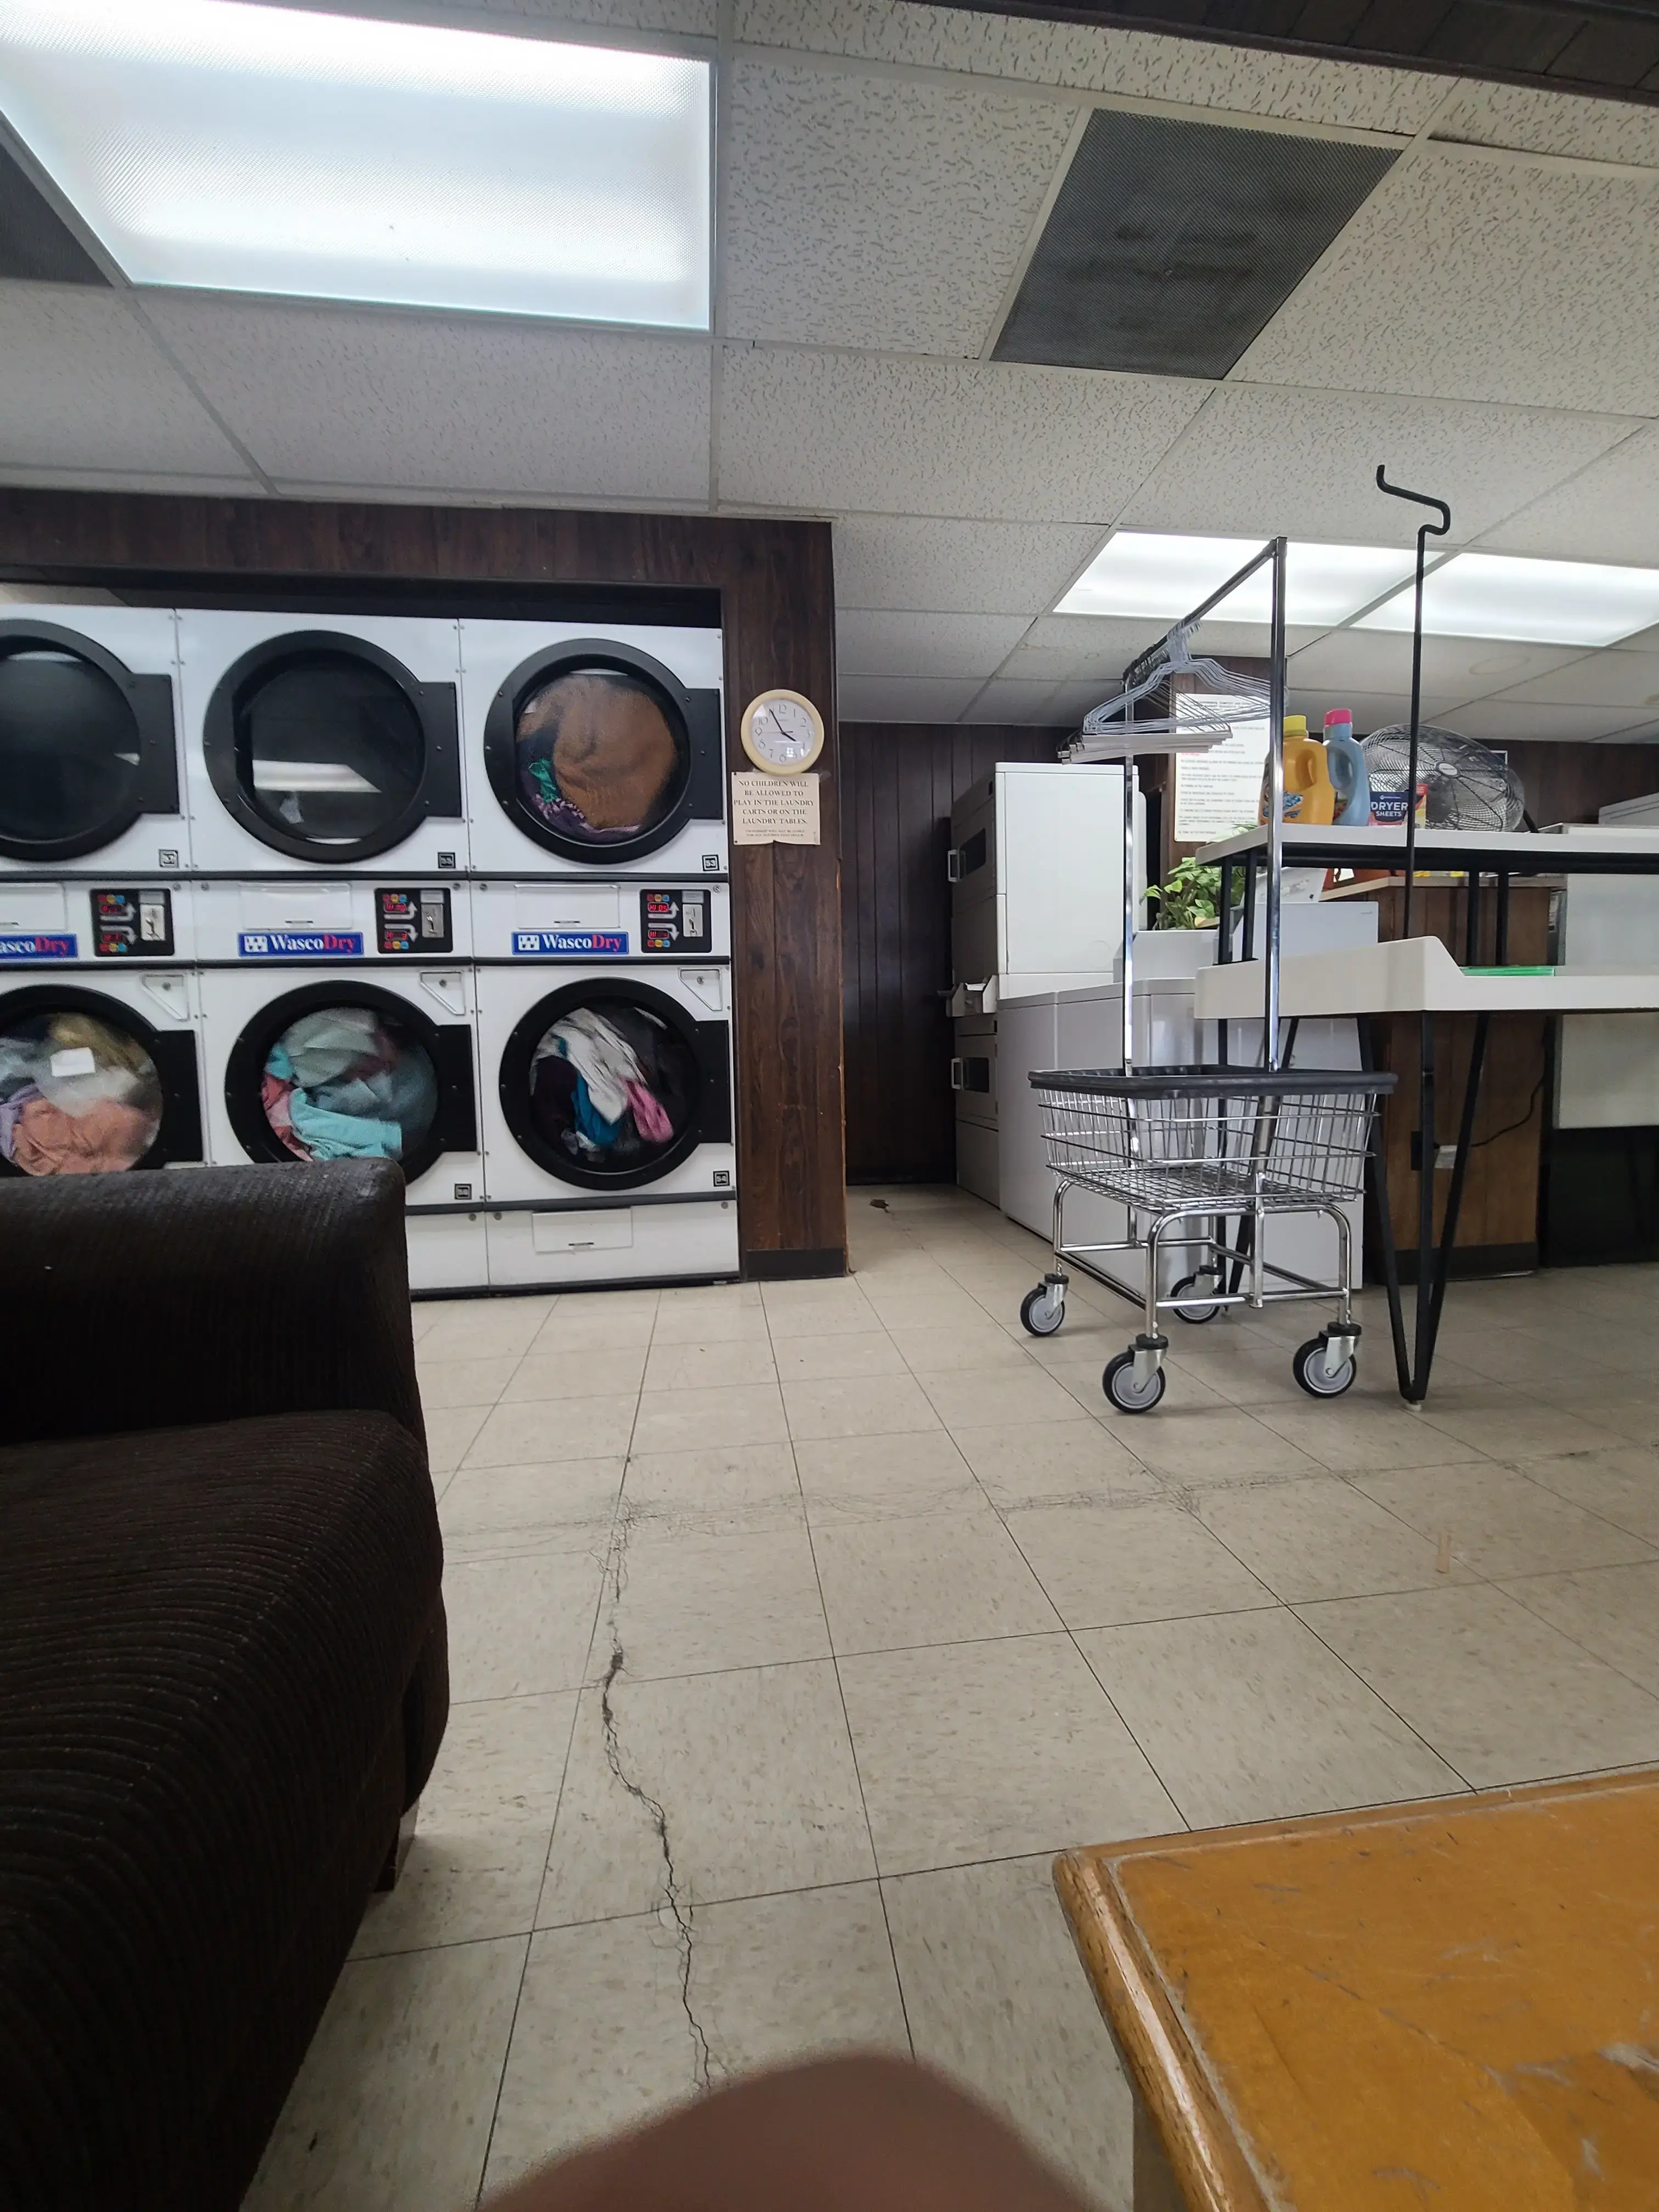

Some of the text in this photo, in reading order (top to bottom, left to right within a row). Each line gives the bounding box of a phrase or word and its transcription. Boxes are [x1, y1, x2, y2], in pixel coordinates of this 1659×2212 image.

[779, 704, 787, 714] 12
[758, 716, 769, 725] 10
[800, 717, 807, 727] 2
[754, 726, 763, 737] 9
[769, 748, 774, 759] 7
[779, 753, 787, 763] 6
[1371, 802, 1408, 811] DRYER
[270, 934, 356, 953] WascoDry
[542, 934, 622, 952] WascoDry
